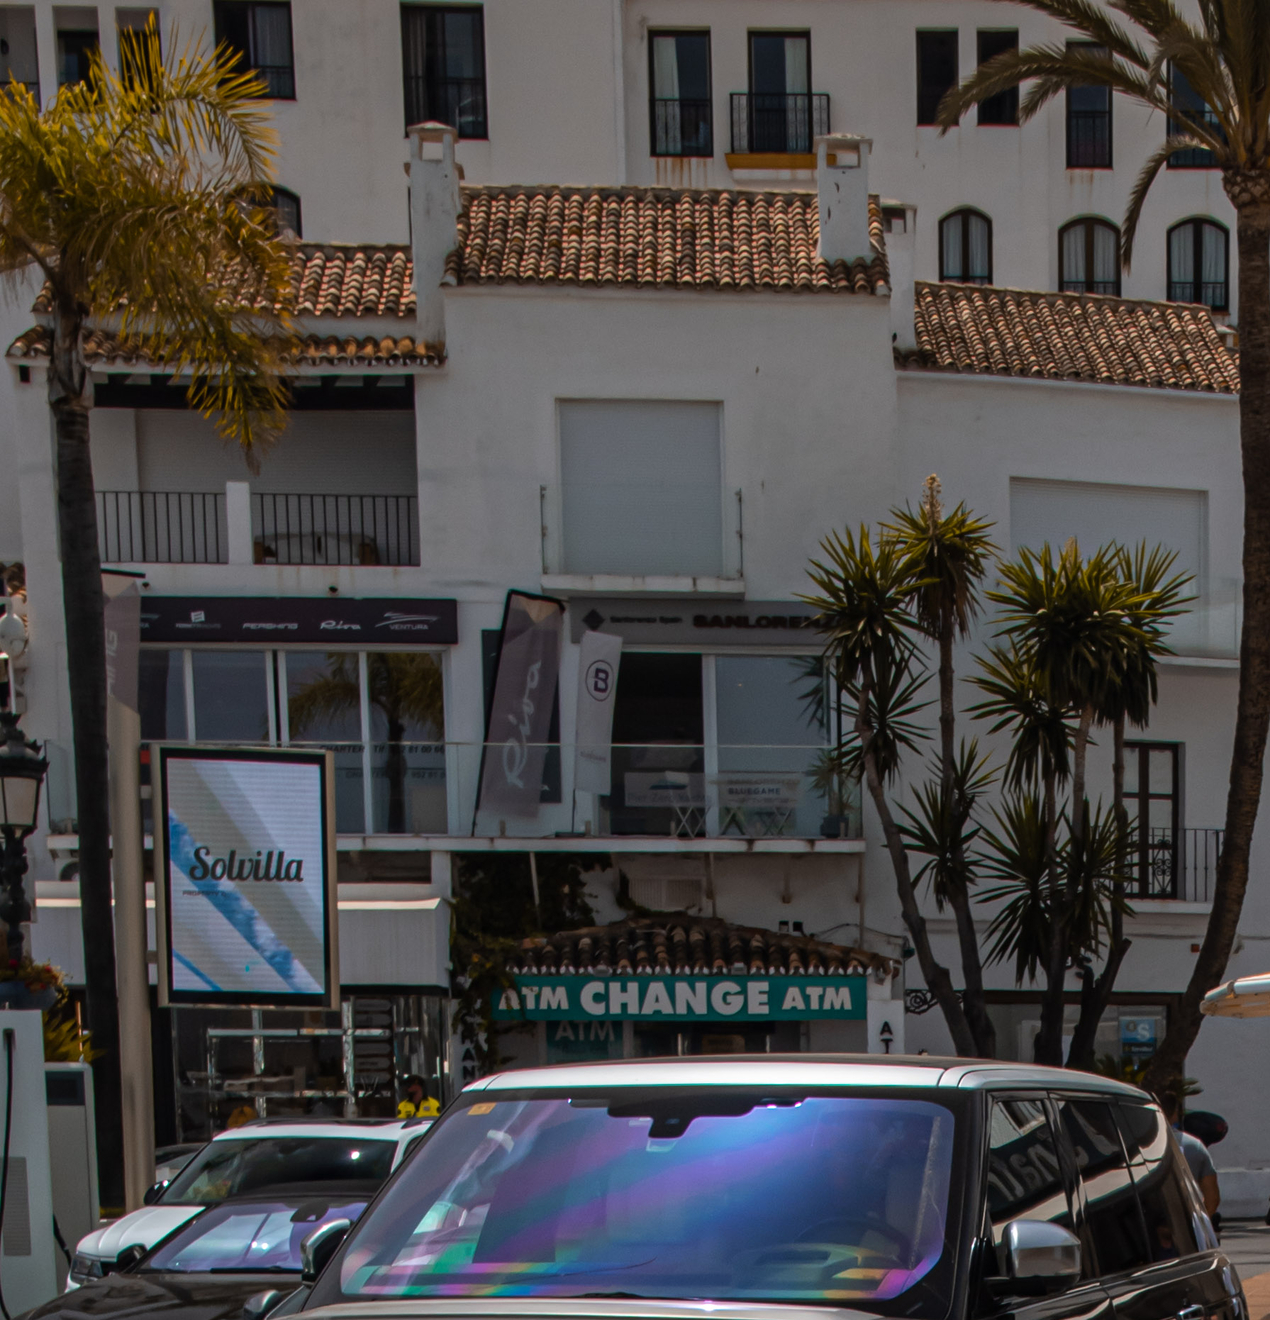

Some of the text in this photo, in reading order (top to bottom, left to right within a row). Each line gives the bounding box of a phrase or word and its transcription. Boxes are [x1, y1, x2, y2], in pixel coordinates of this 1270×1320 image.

[320, 620, 361, 631] Riva
[389, 623, 429, 631] VENTURA
[502, 660, 542, 790] Riva
[728, 787, 781, 796] BLUEGAME
[188, 846, 304, 882] Solvilla
[498, 980, 852, 1016] ATM CHANGE ATM
[554, 1020, 615, 1042] ATM
